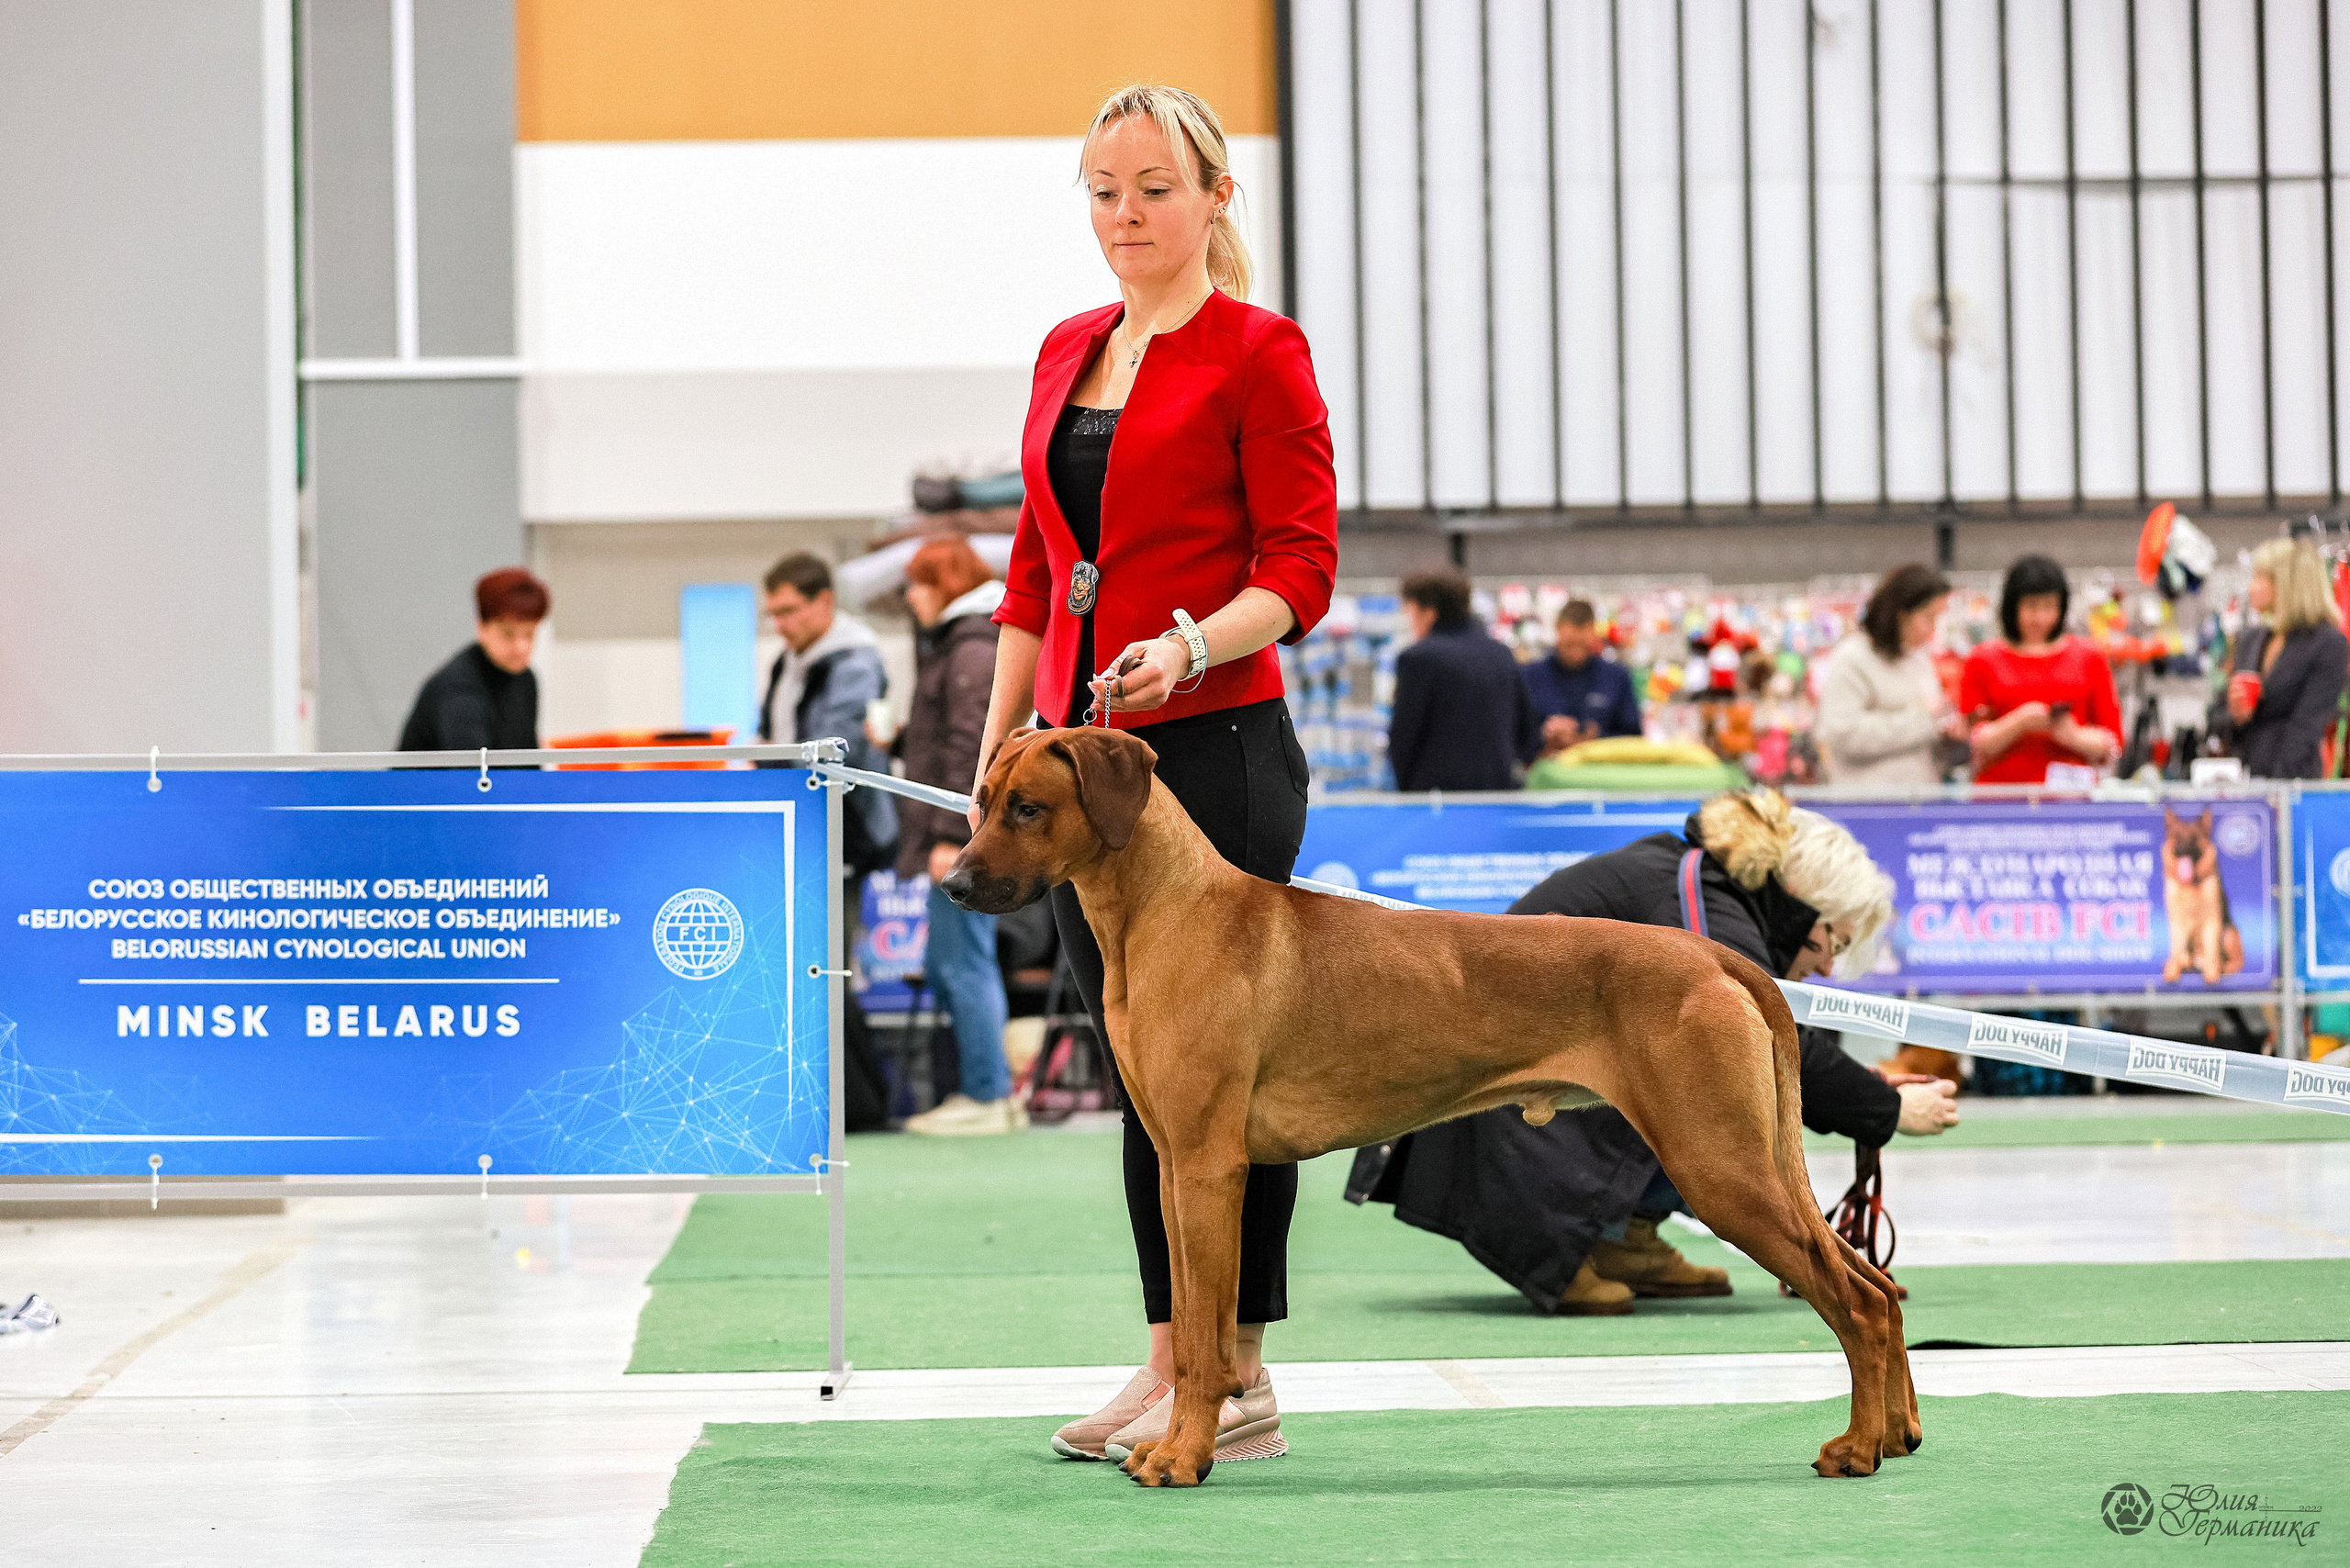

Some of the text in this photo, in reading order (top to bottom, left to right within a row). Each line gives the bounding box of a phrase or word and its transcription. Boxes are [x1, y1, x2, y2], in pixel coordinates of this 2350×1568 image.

[88, 874, 549, 902] СОЮЗ ОБЩЕСТВЕННЫХ ОБЪЕДИНЕНИЙ
[17, 908, 621, 931] «БЕЛОРУССКОЕ КИНОЛОГИЧЕСКОЕ ОБЪЕДИНЕНИЕ»
[679, 926, 716, 941] FCI
[111, 938, 527, 959] BELORUSSIAN CYNOLOGICAL UNION
[118, 1004, 521, 1037] MINSK BELARUS
